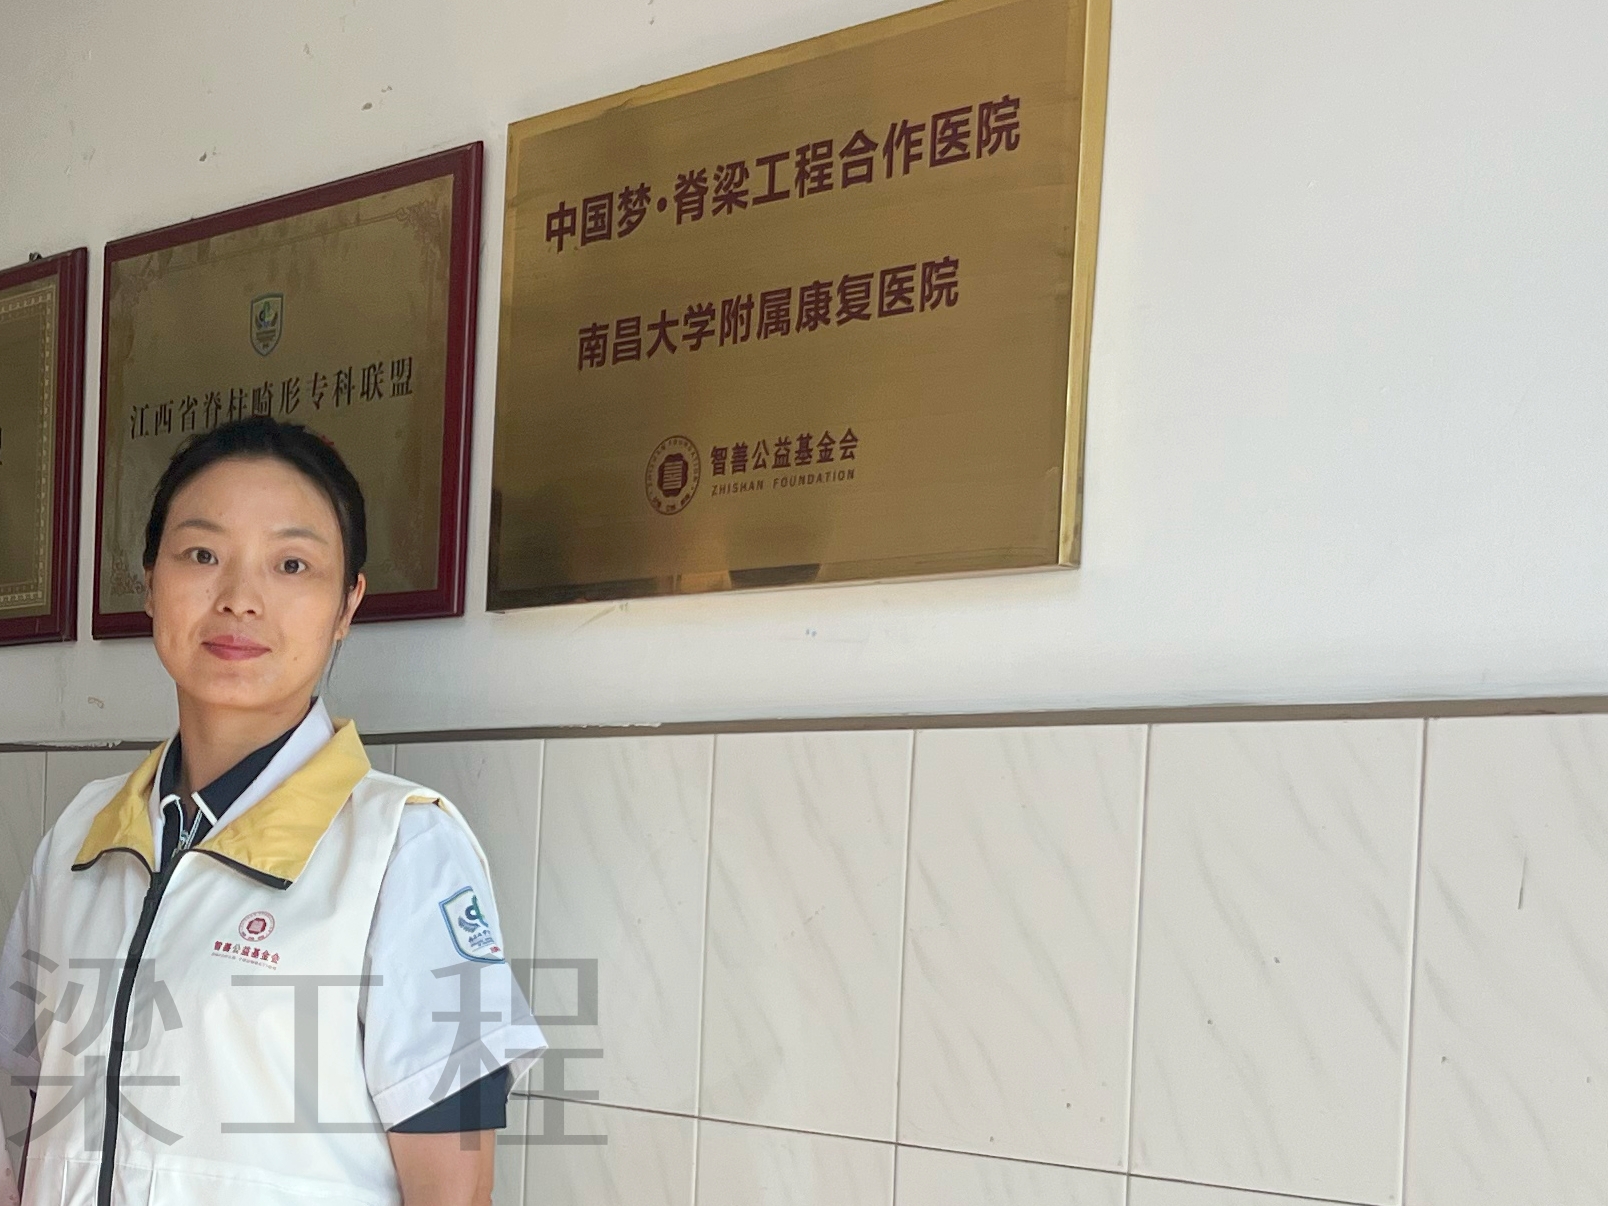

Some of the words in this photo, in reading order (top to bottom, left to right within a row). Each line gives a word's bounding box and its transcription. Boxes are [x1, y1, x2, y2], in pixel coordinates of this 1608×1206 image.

[545, 95, 1021, 253] 中国梦·脊梁工程合作医院
[577, 256, 960, 371] 南昌大学附属康复医院
[130, 357, 413, 439] 江西省脊柱畸形专科联盟
[710, 428, 859, 477] 智善公益基金会
[711, 480, 763, 497] ZHISHAN
[772, 469, 855, 490] FOUNDATION
